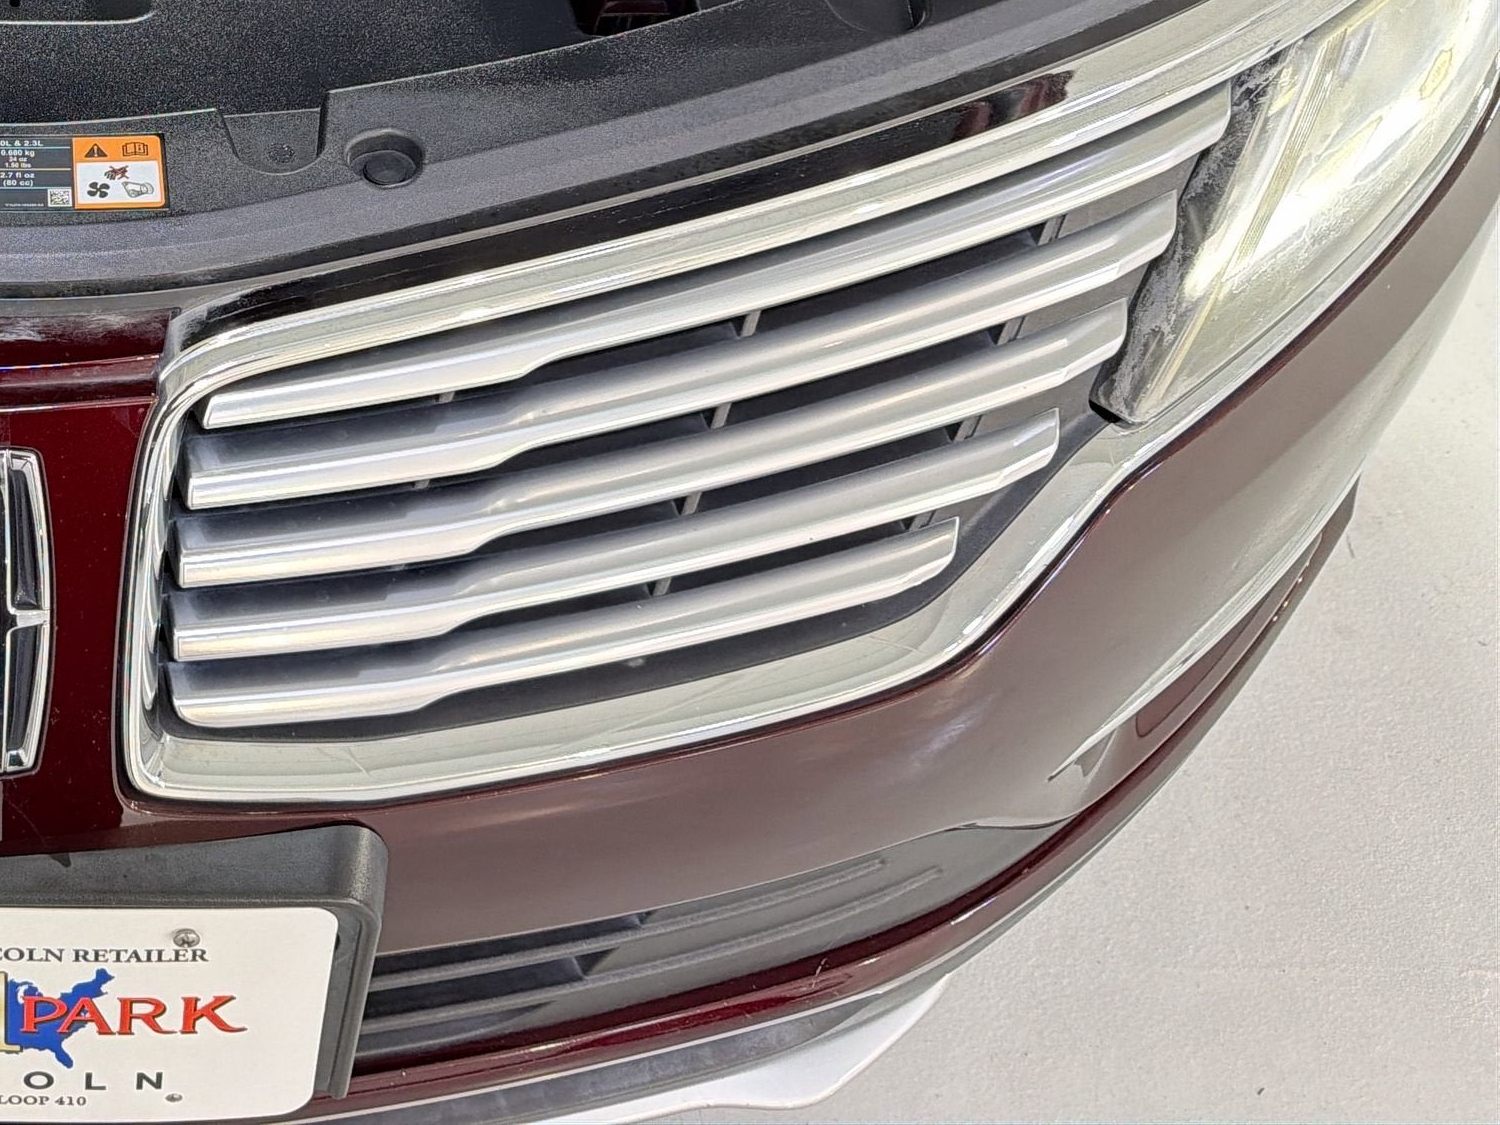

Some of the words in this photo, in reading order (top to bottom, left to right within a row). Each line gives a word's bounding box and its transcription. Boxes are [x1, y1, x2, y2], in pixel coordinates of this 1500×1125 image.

[24, 149, 35, 157] kg
[15, 171, 22, 179] fl
[71, 947, 210, 964] RETAILER
[19, 994, 248, 1036] PARK
[55, 1095, 87, 1107] 410
